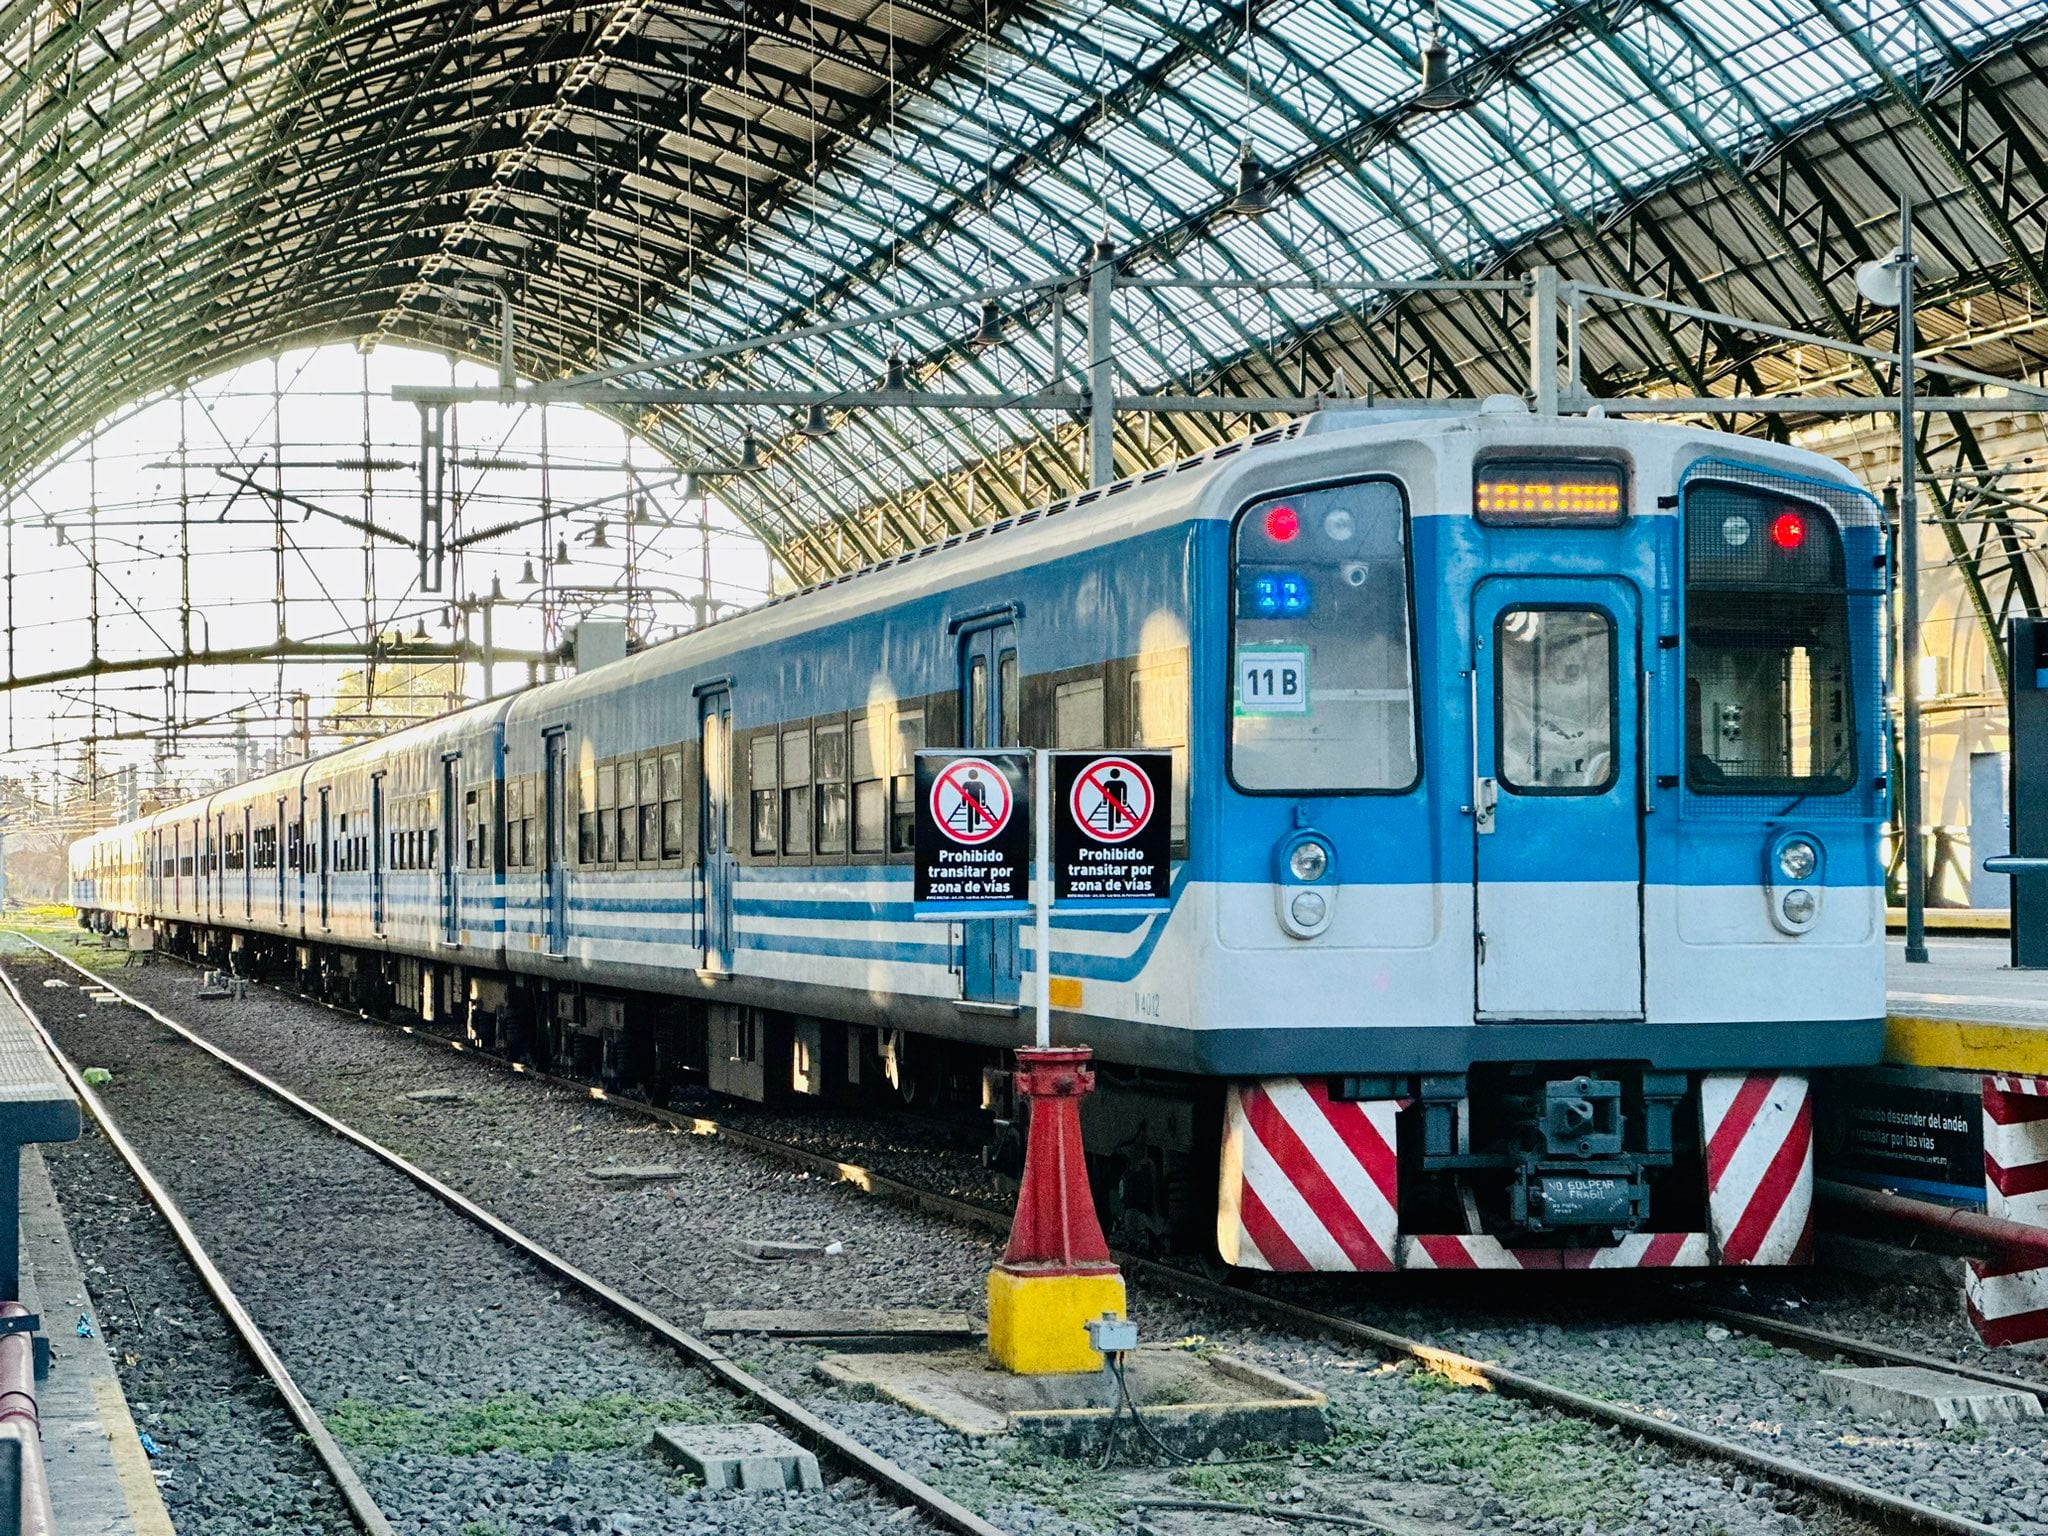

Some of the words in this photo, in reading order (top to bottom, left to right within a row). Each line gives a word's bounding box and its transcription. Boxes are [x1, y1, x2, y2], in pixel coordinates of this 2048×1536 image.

[939, 849, 1004, 863] Prohibido
[1079, 848, 1144, 861] Prohibido
[928, 865, 987, 878] transitar
[990, 867, 1014, 880] por
[1068, 863, 1128, 876] transitar
[1131, 865, 1154, 878] por
[930, 883, 962, 893] zona
[964, 881, 981, 893] de
[983, 879, 1011, 893] vías
[1070, 881, 1103, 892] zona
[1105, 879, 1122, 891] de
[1124, 877, 1152, 891] vías
[1886, 1110, 1926, 1127] descender
[1928, 1112, 1942, 1130] del
[1942, 1115, 1969, 1134] andén
[1891, 1133, 1904, 1148] por
[1905, 1131, 1918, 1148] las
[1919, 1132, 1935, 1150] vías
[1567, 1180, 1616, 1190] GOLPEAR
